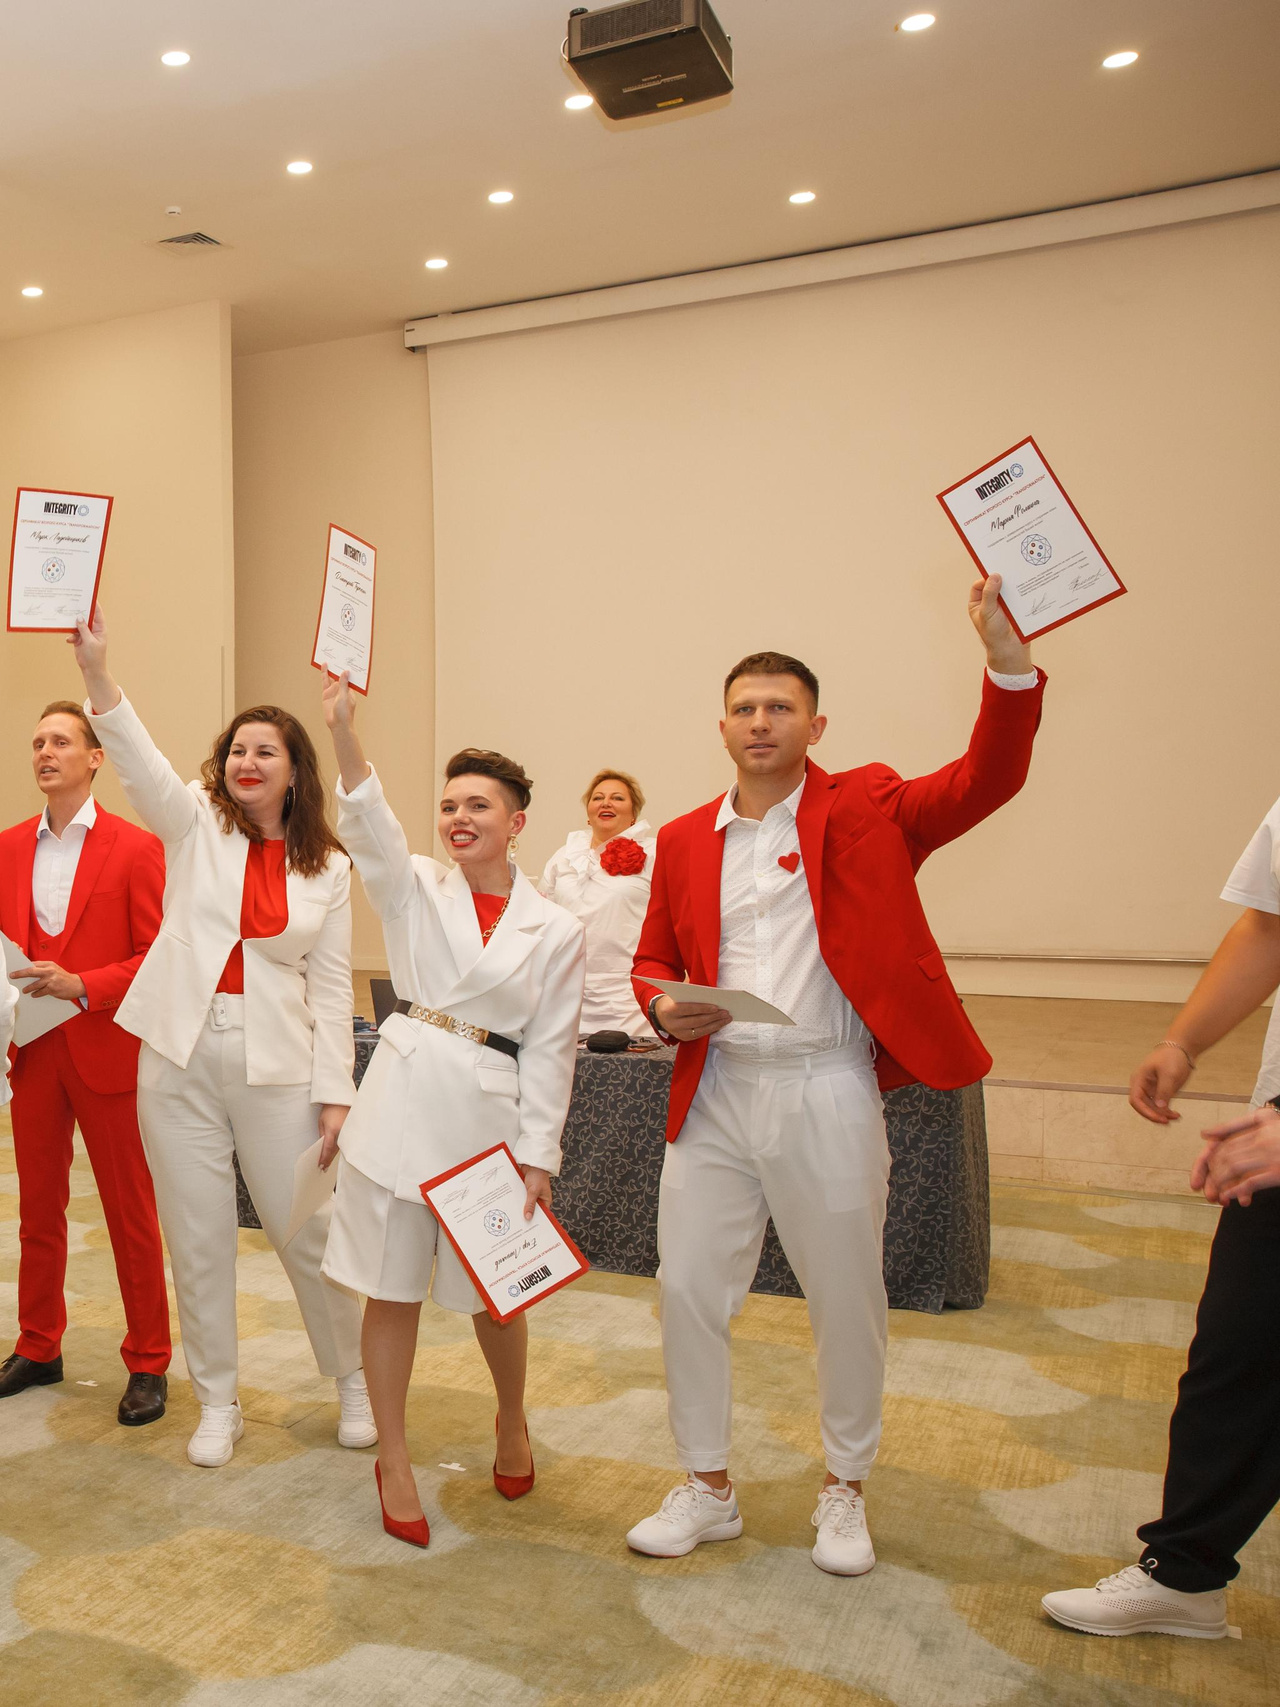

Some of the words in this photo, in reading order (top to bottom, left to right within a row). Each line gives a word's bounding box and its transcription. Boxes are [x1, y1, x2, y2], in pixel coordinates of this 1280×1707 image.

[974, 467, 1015, 501] INTEGRITY
[44, 501, 78, 515] INTEGRITY
[515, 1263, 552, 1293] INTEGRITY
